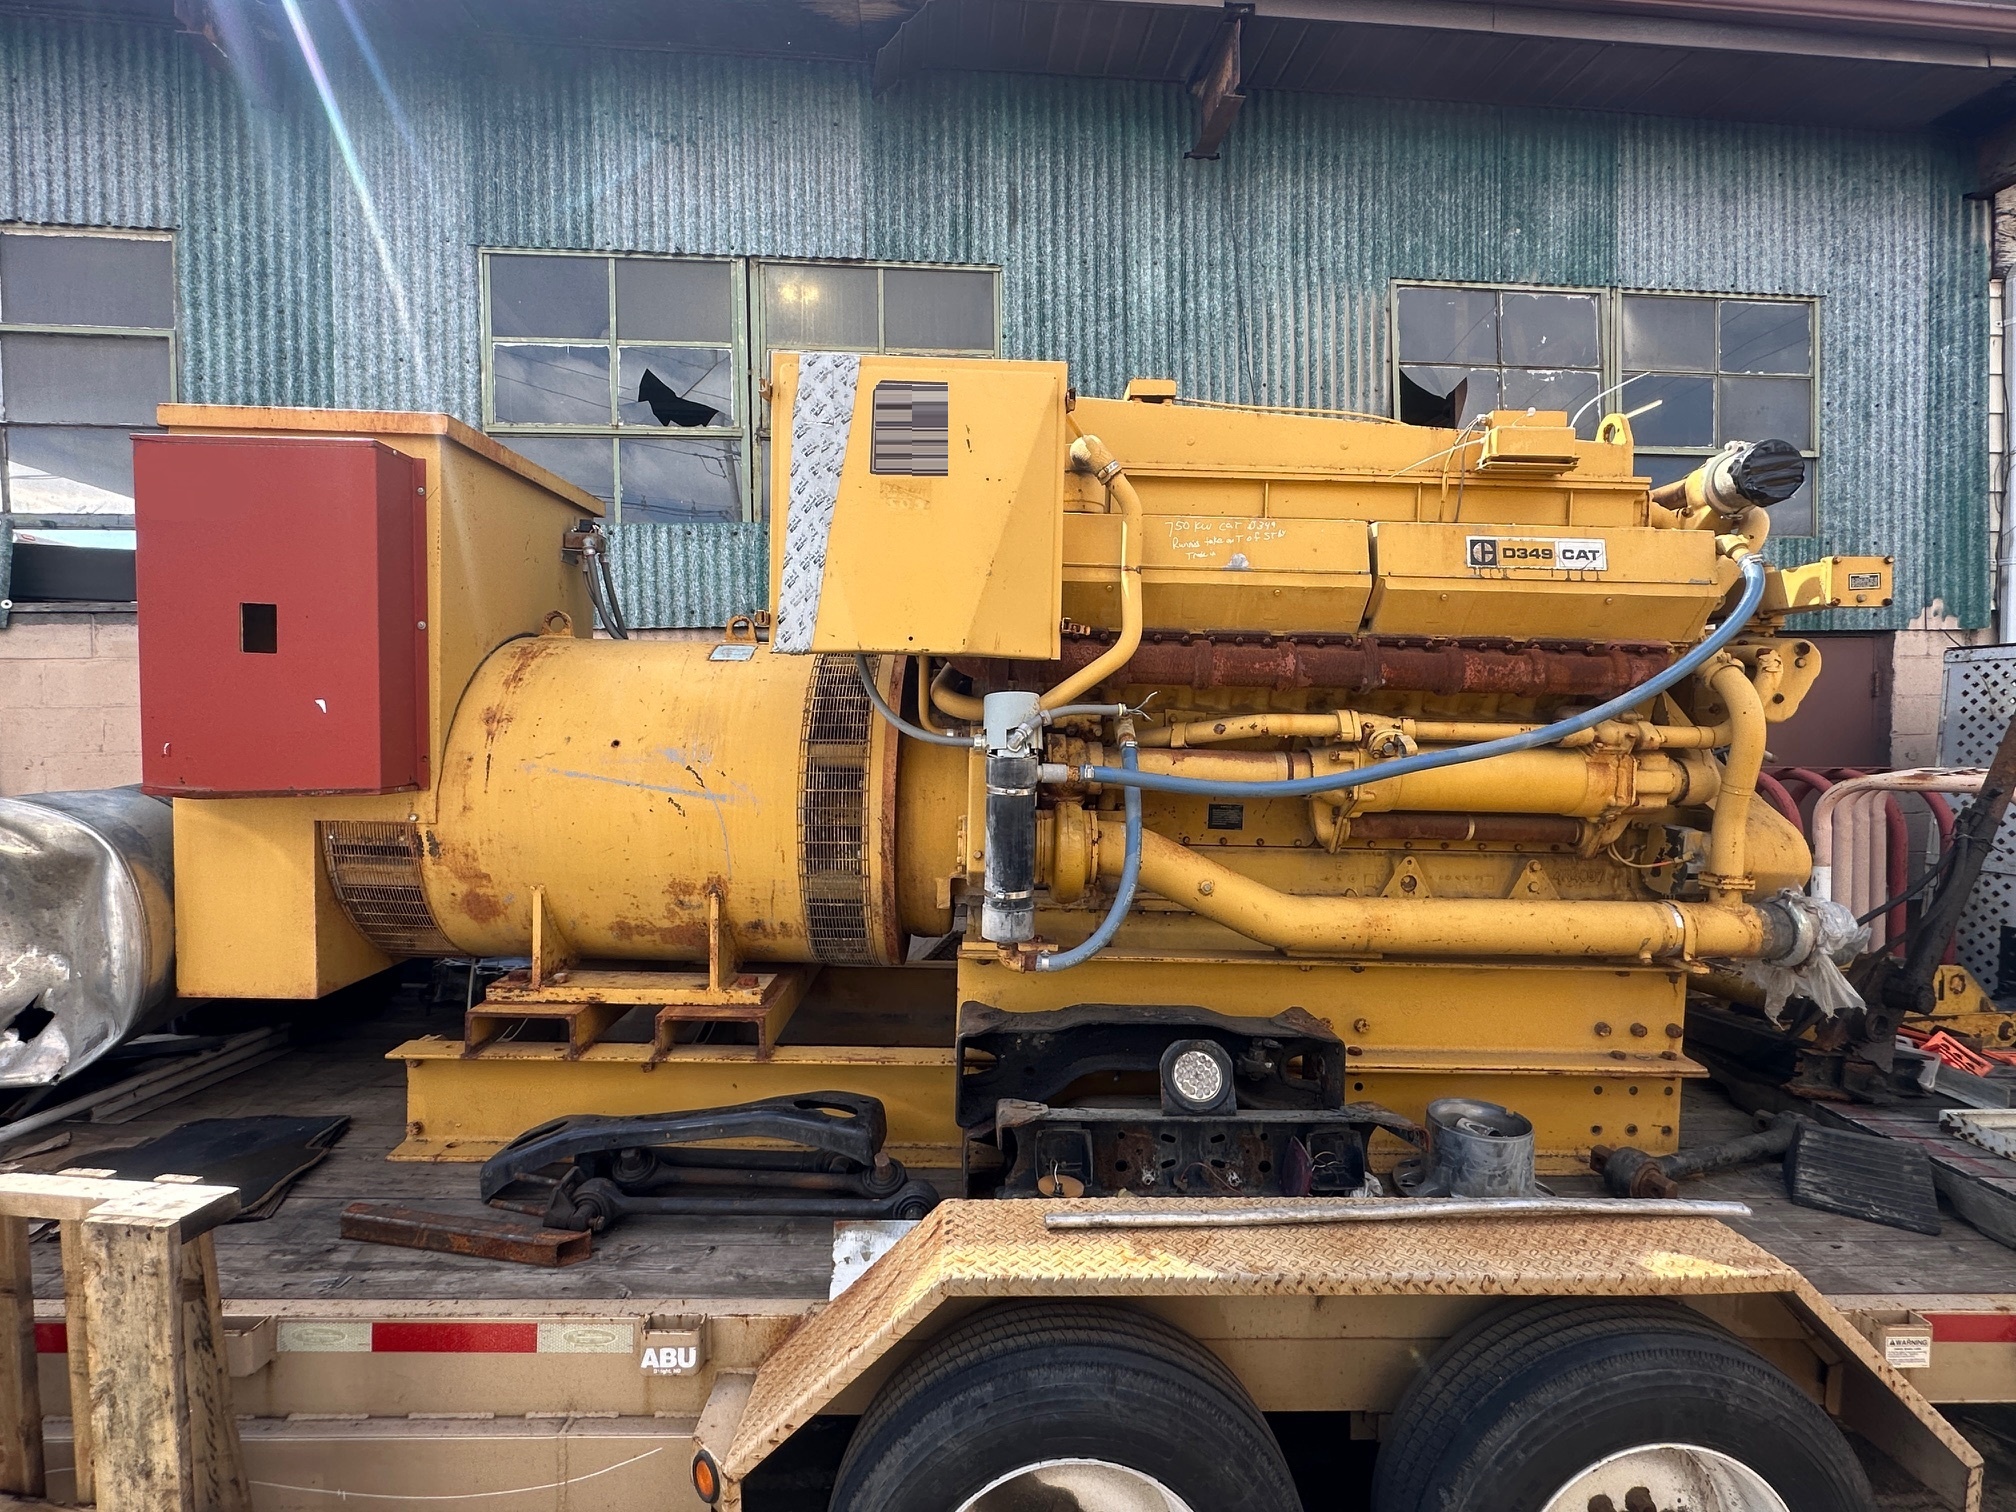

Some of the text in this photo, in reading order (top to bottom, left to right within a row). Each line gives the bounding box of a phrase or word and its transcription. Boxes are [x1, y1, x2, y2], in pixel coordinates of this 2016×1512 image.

[1165, 520, 1190, 537] 750
[1502, 548, 1600, 561] D349 CAT
[640, 1346, 697, 1369] ABU
